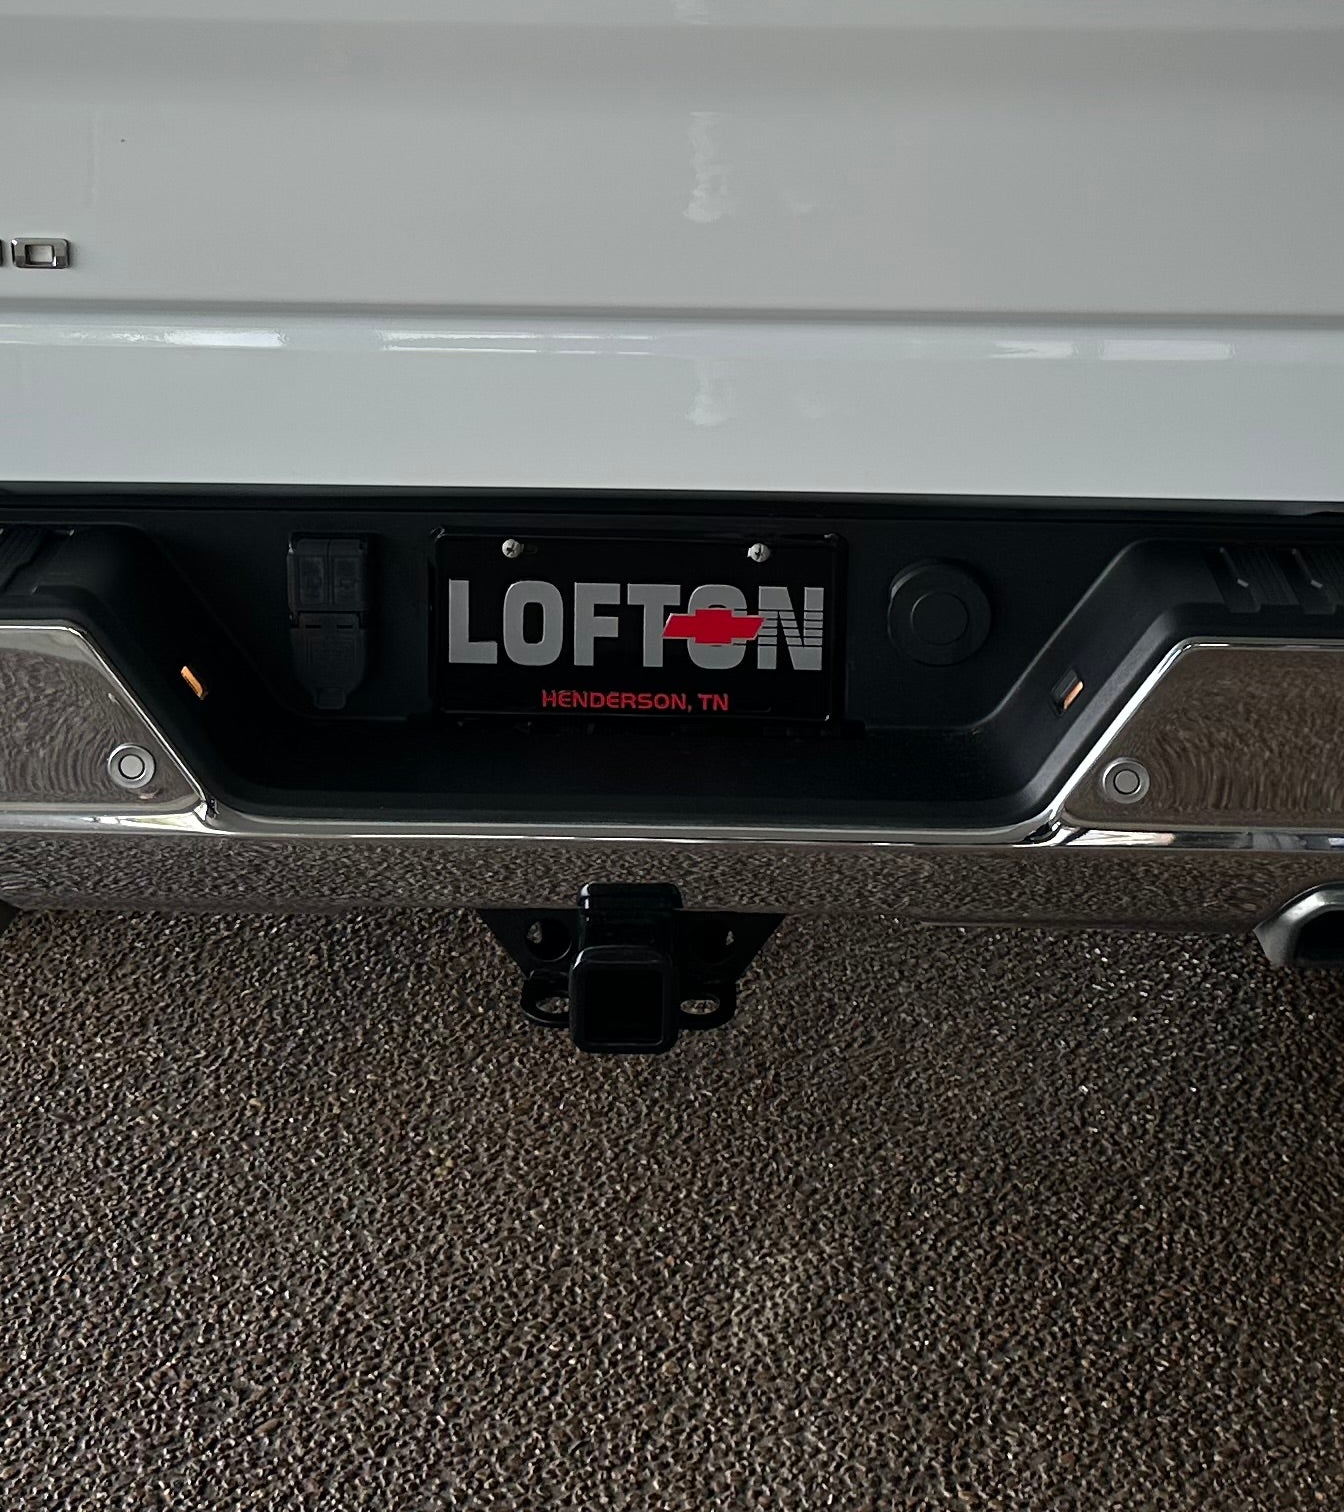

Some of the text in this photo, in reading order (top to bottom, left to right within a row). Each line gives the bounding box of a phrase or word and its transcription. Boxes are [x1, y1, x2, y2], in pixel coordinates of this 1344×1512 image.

[449, 579, 824, 670] LOFTON
[541, 690, 729, 712] HENDERSON, TN
